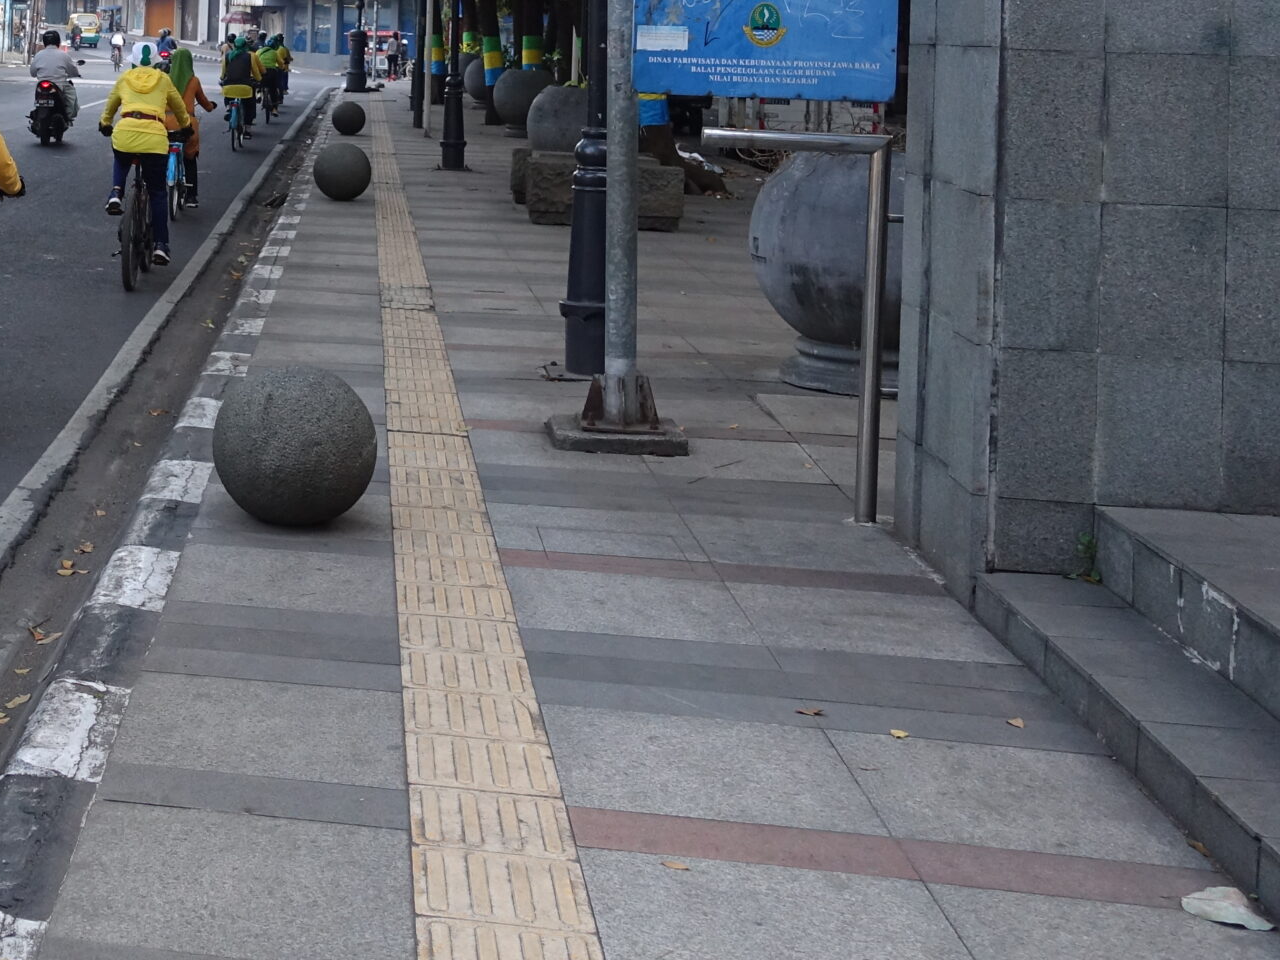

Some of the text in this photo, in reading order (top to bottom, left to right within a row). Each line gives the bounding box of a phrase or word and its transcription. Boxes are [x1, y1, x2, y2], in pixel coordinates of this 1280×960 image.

[673, 57, 720, 65] PARIWISATA
[740, 59, 792, 67] KEBUDAYAAN
[793, 60, 831, 68] PROVINSI
[854, 62, 880, 70] BARAT
[716, 67, 775, 75] PENGELOLAAN
[776, 68, 804, 76] CAGAR
[805, 69, 837, 77] BUDAYA
[732, 75, 763, 83] BUDAYA
[782, 77, 818, 85] SEJARAH
